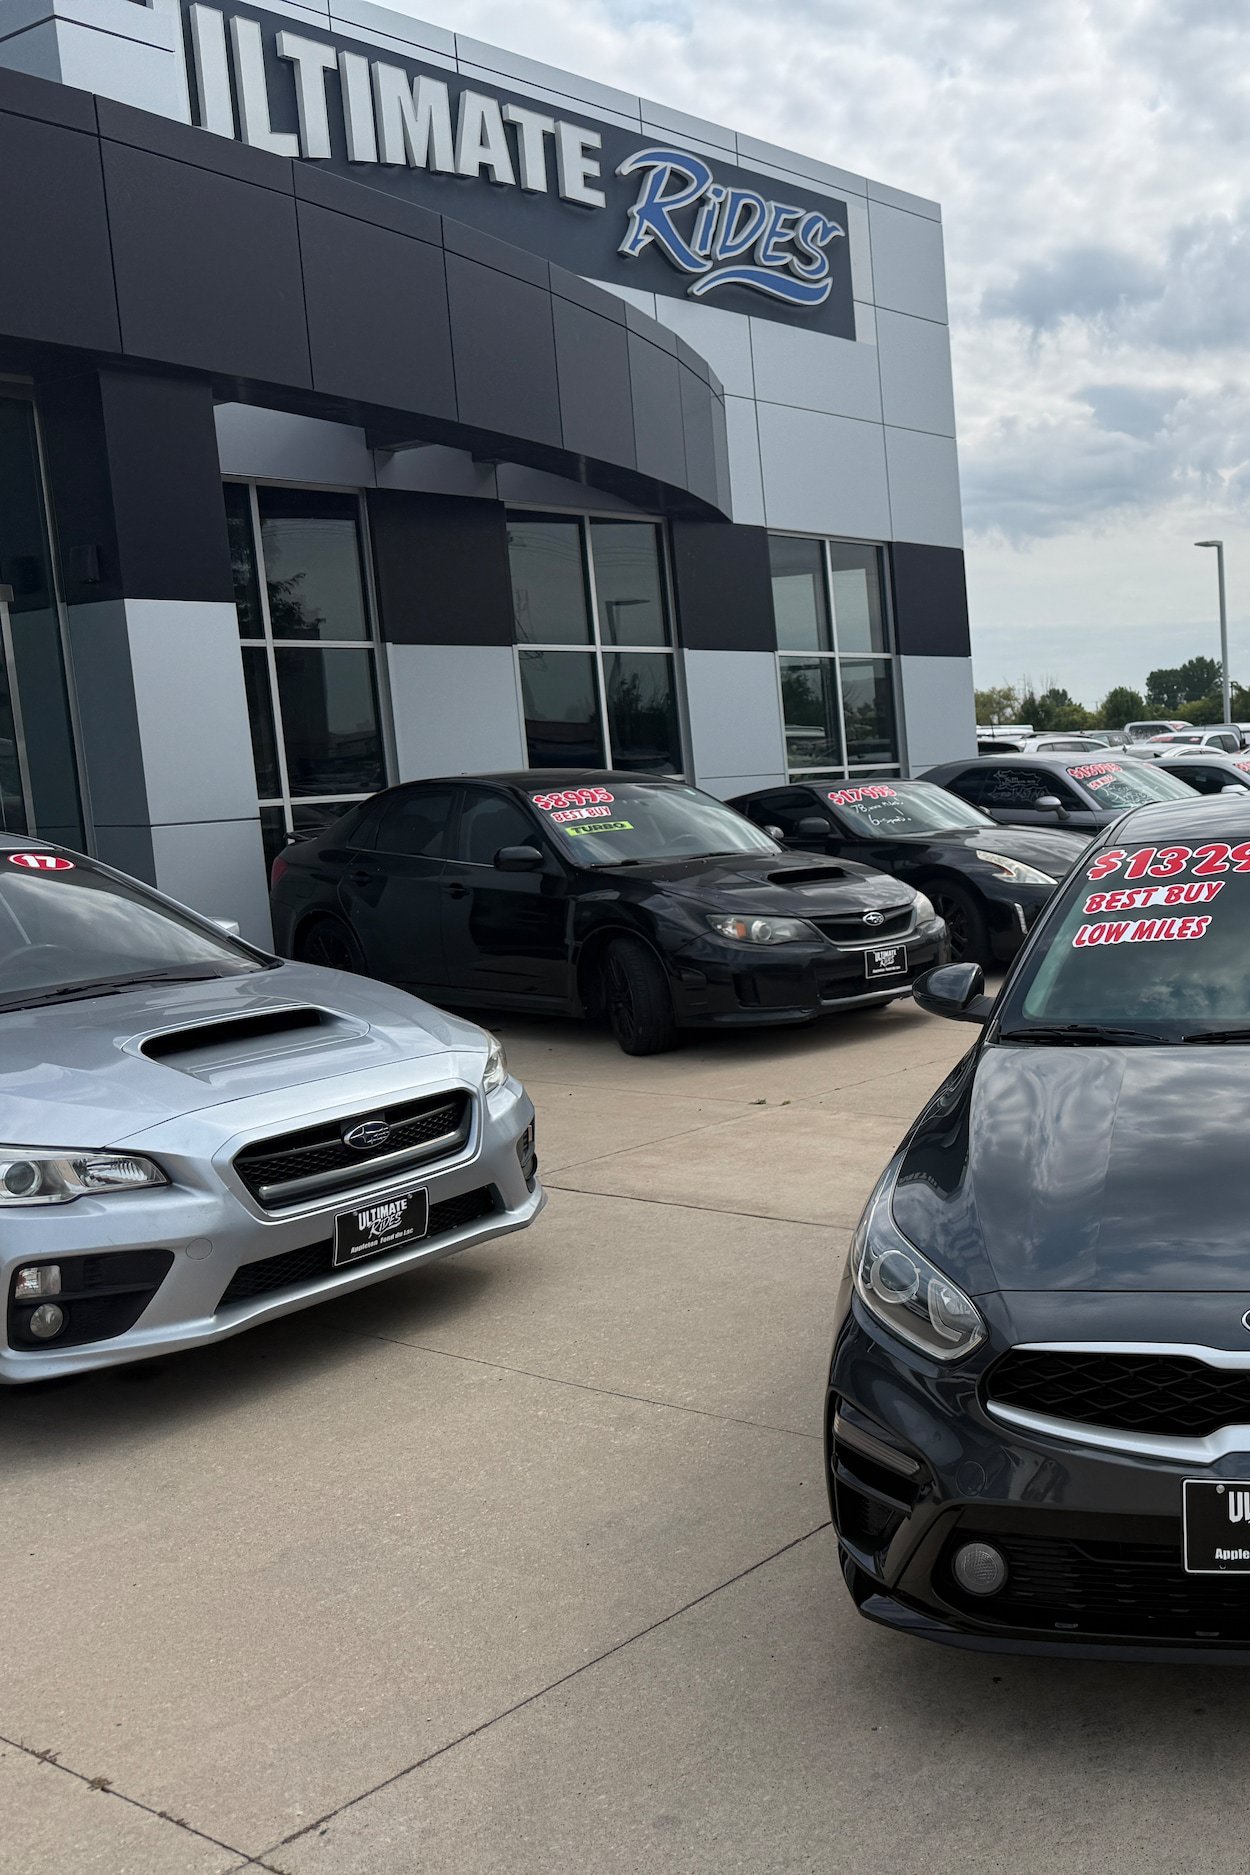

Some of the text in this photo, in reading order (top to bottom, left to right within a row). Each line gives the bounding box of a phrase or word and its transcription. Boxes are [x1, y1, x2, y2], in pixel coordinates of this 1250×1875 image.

[533, 787, 615, 810] $8995
[828, 785, 896, 805] $17995
[551, 806, 611, 823] BEST BUY
[570, 822, 625, 834] TURBO
[21, 855, 57, 868] 17
[1083, 881, 1225, 914] BEST BUY
[1073, 916, 1212, 947] LOW MILES
[358, 1199, 408, 1231] ULTIMATE
